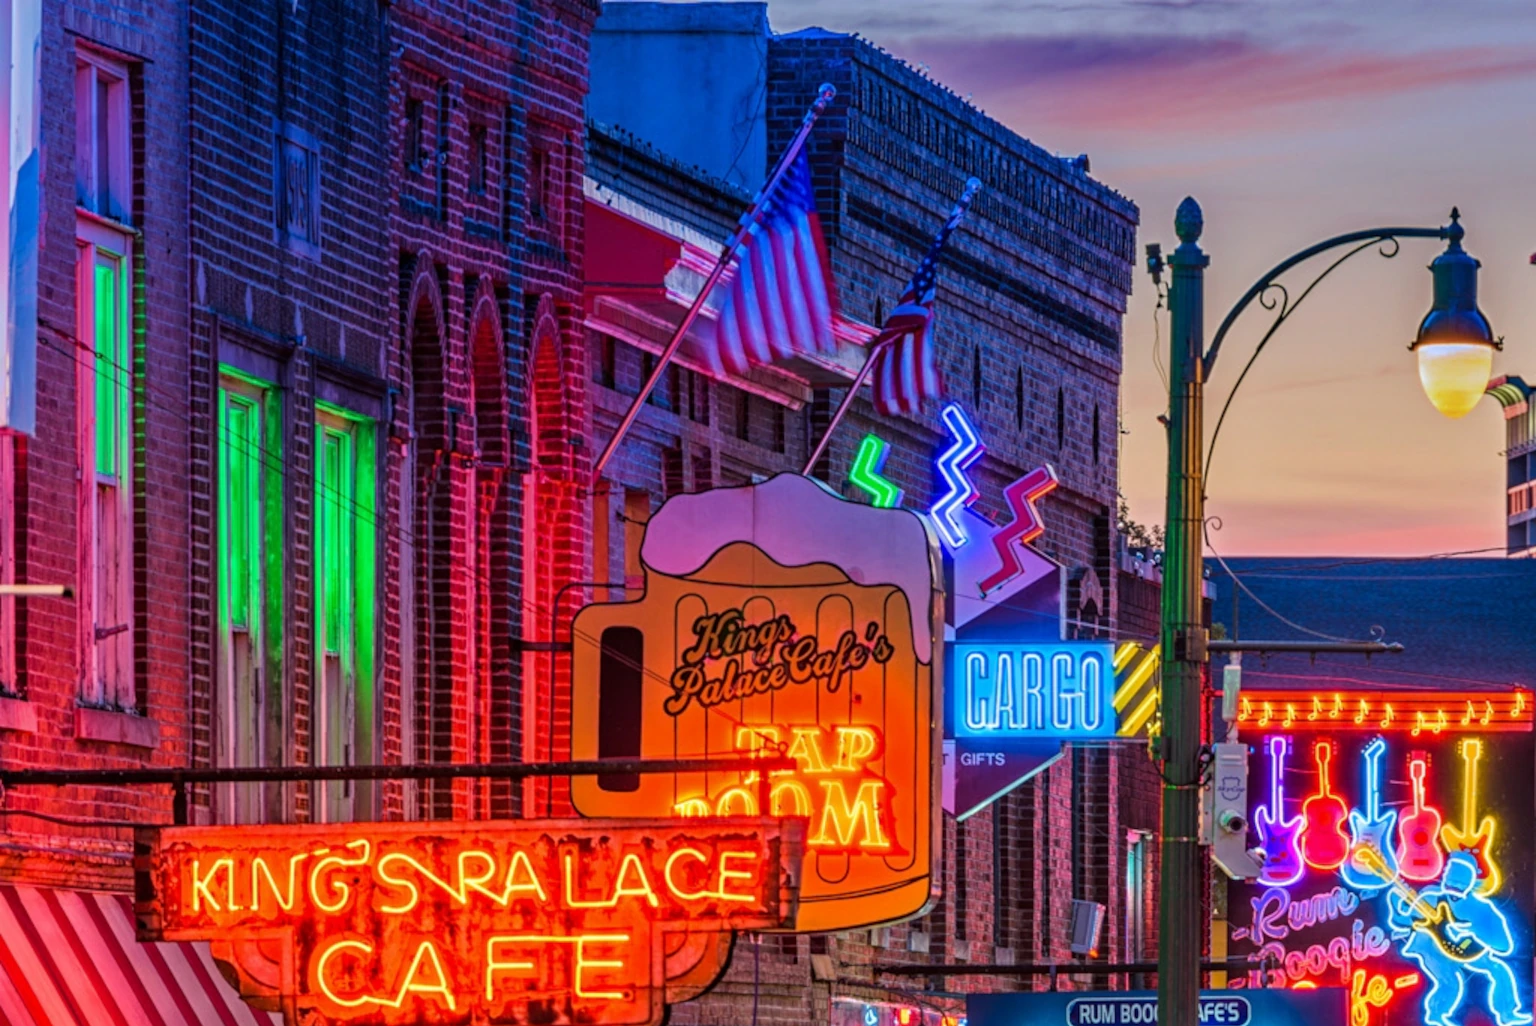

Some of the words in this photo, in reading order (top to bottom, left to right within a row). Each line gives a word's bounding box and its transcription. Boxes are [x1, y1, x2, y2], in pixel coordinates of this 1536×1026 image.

[682, 608, 796, 666] Kings
[663, 658, 788, 717] Palace
[781, 621, 894, 693] Cafe's
[965, 651, 1104, 731] CARGO
[736, 727, 876, 784] TAP
[960, 752, 1006, 766] GIFTS
[1251, 887, 1360, 946] Rum
[316, 934, 630, 1010] CAFE
[1079, 1004, 1116, 1024] RUM
[1198, 1001, 1240, 1023] AFE'S
